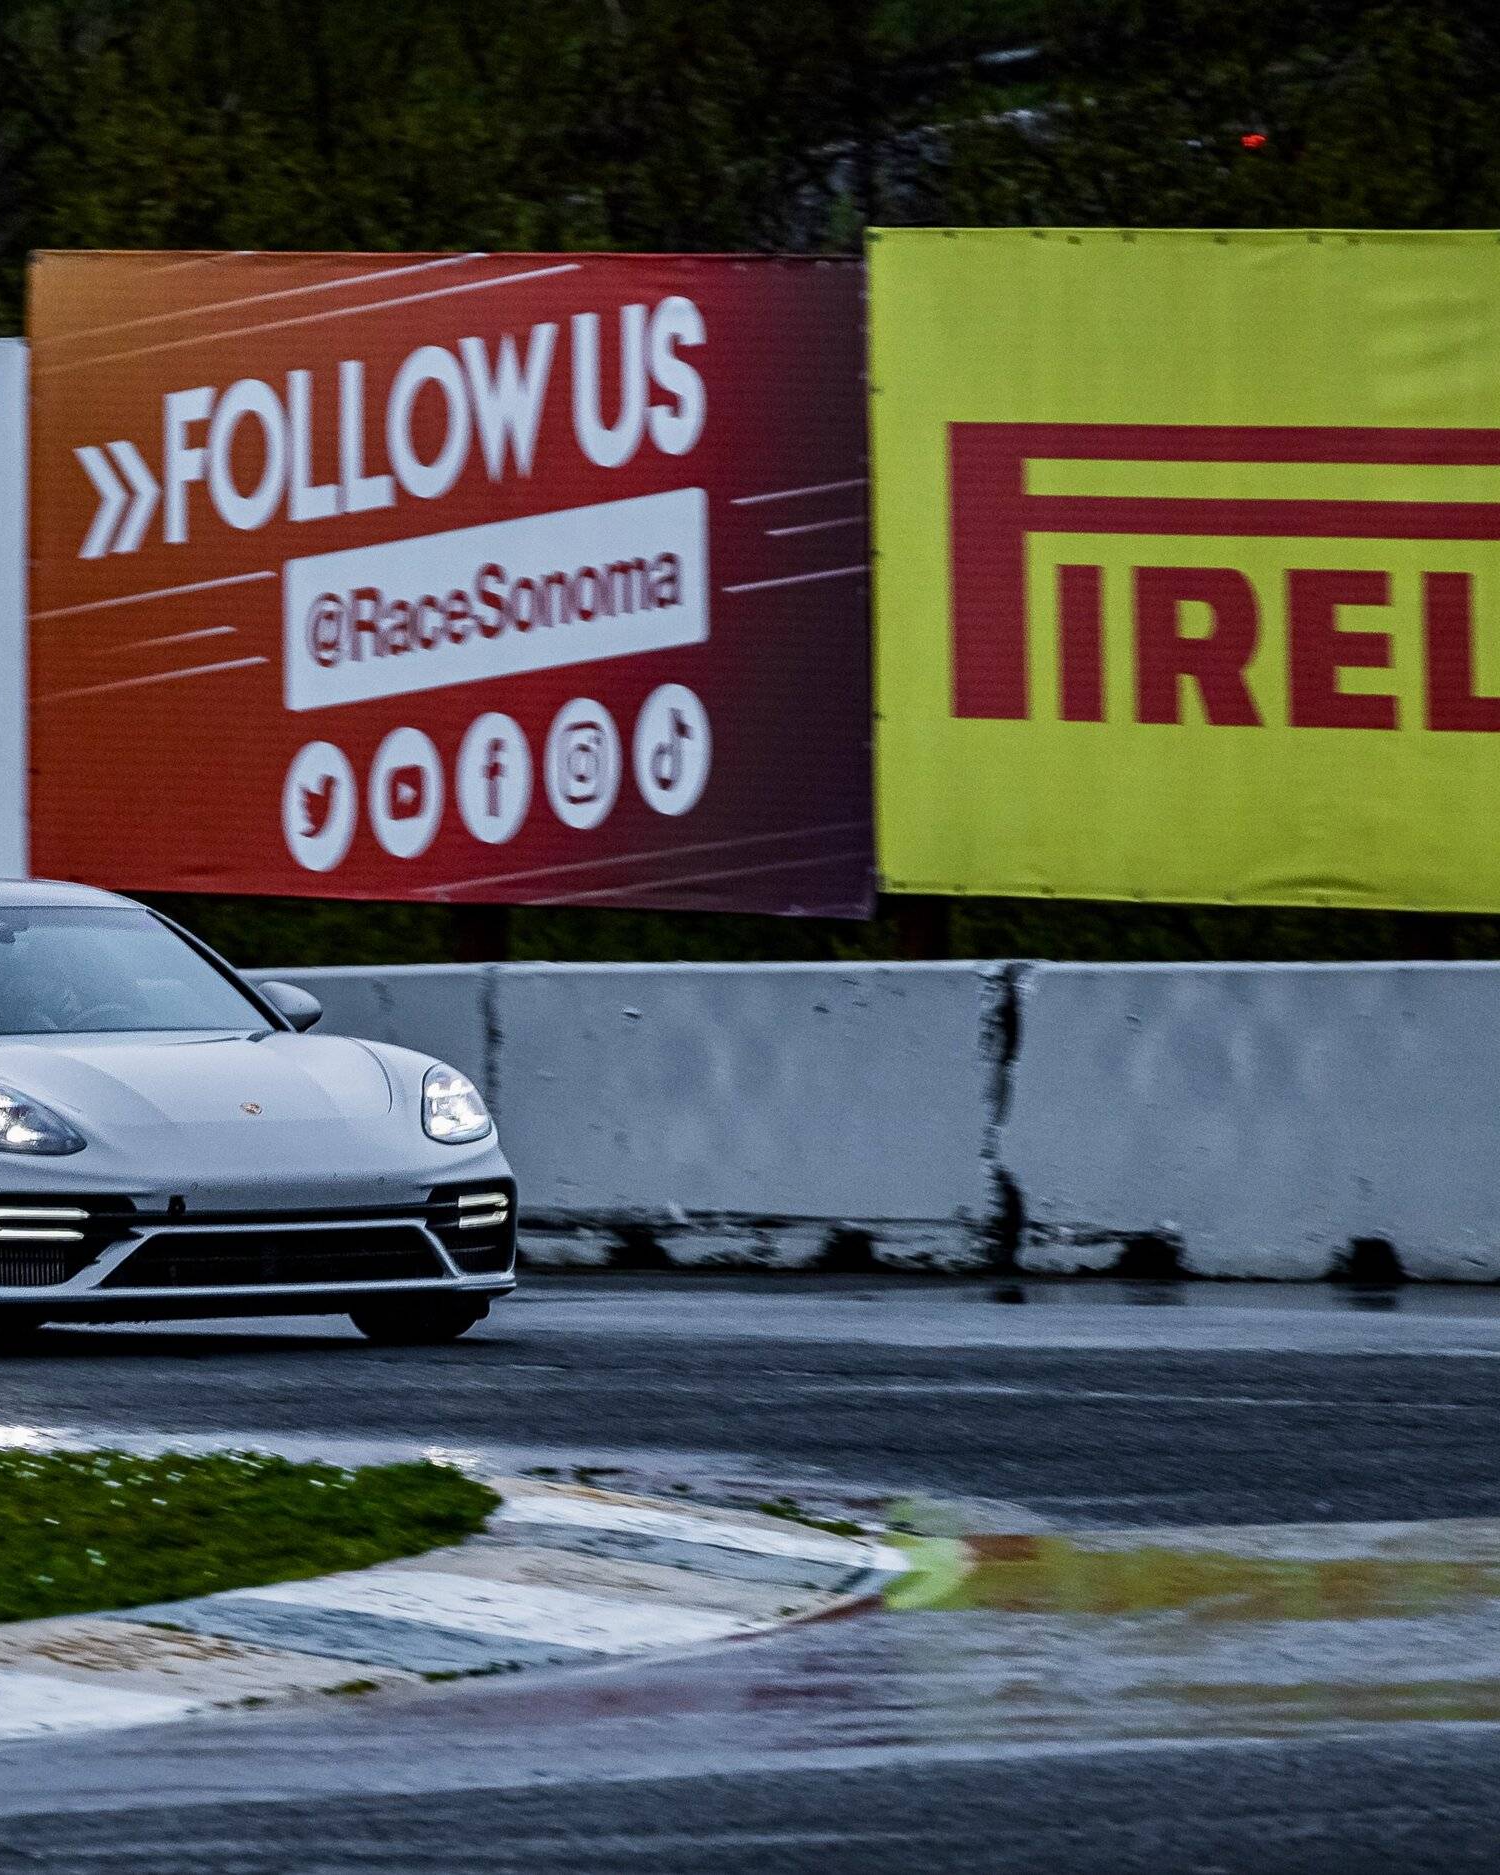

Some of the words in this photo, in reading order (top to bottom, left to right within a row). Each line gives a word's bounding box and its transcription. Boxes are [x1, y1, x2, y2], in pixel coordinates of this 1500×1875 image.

[162, 321, 560, 545] FOLLOW
[571, 296, 708, 469] US
[306, 549, 684, 668] @RaceSonoma
